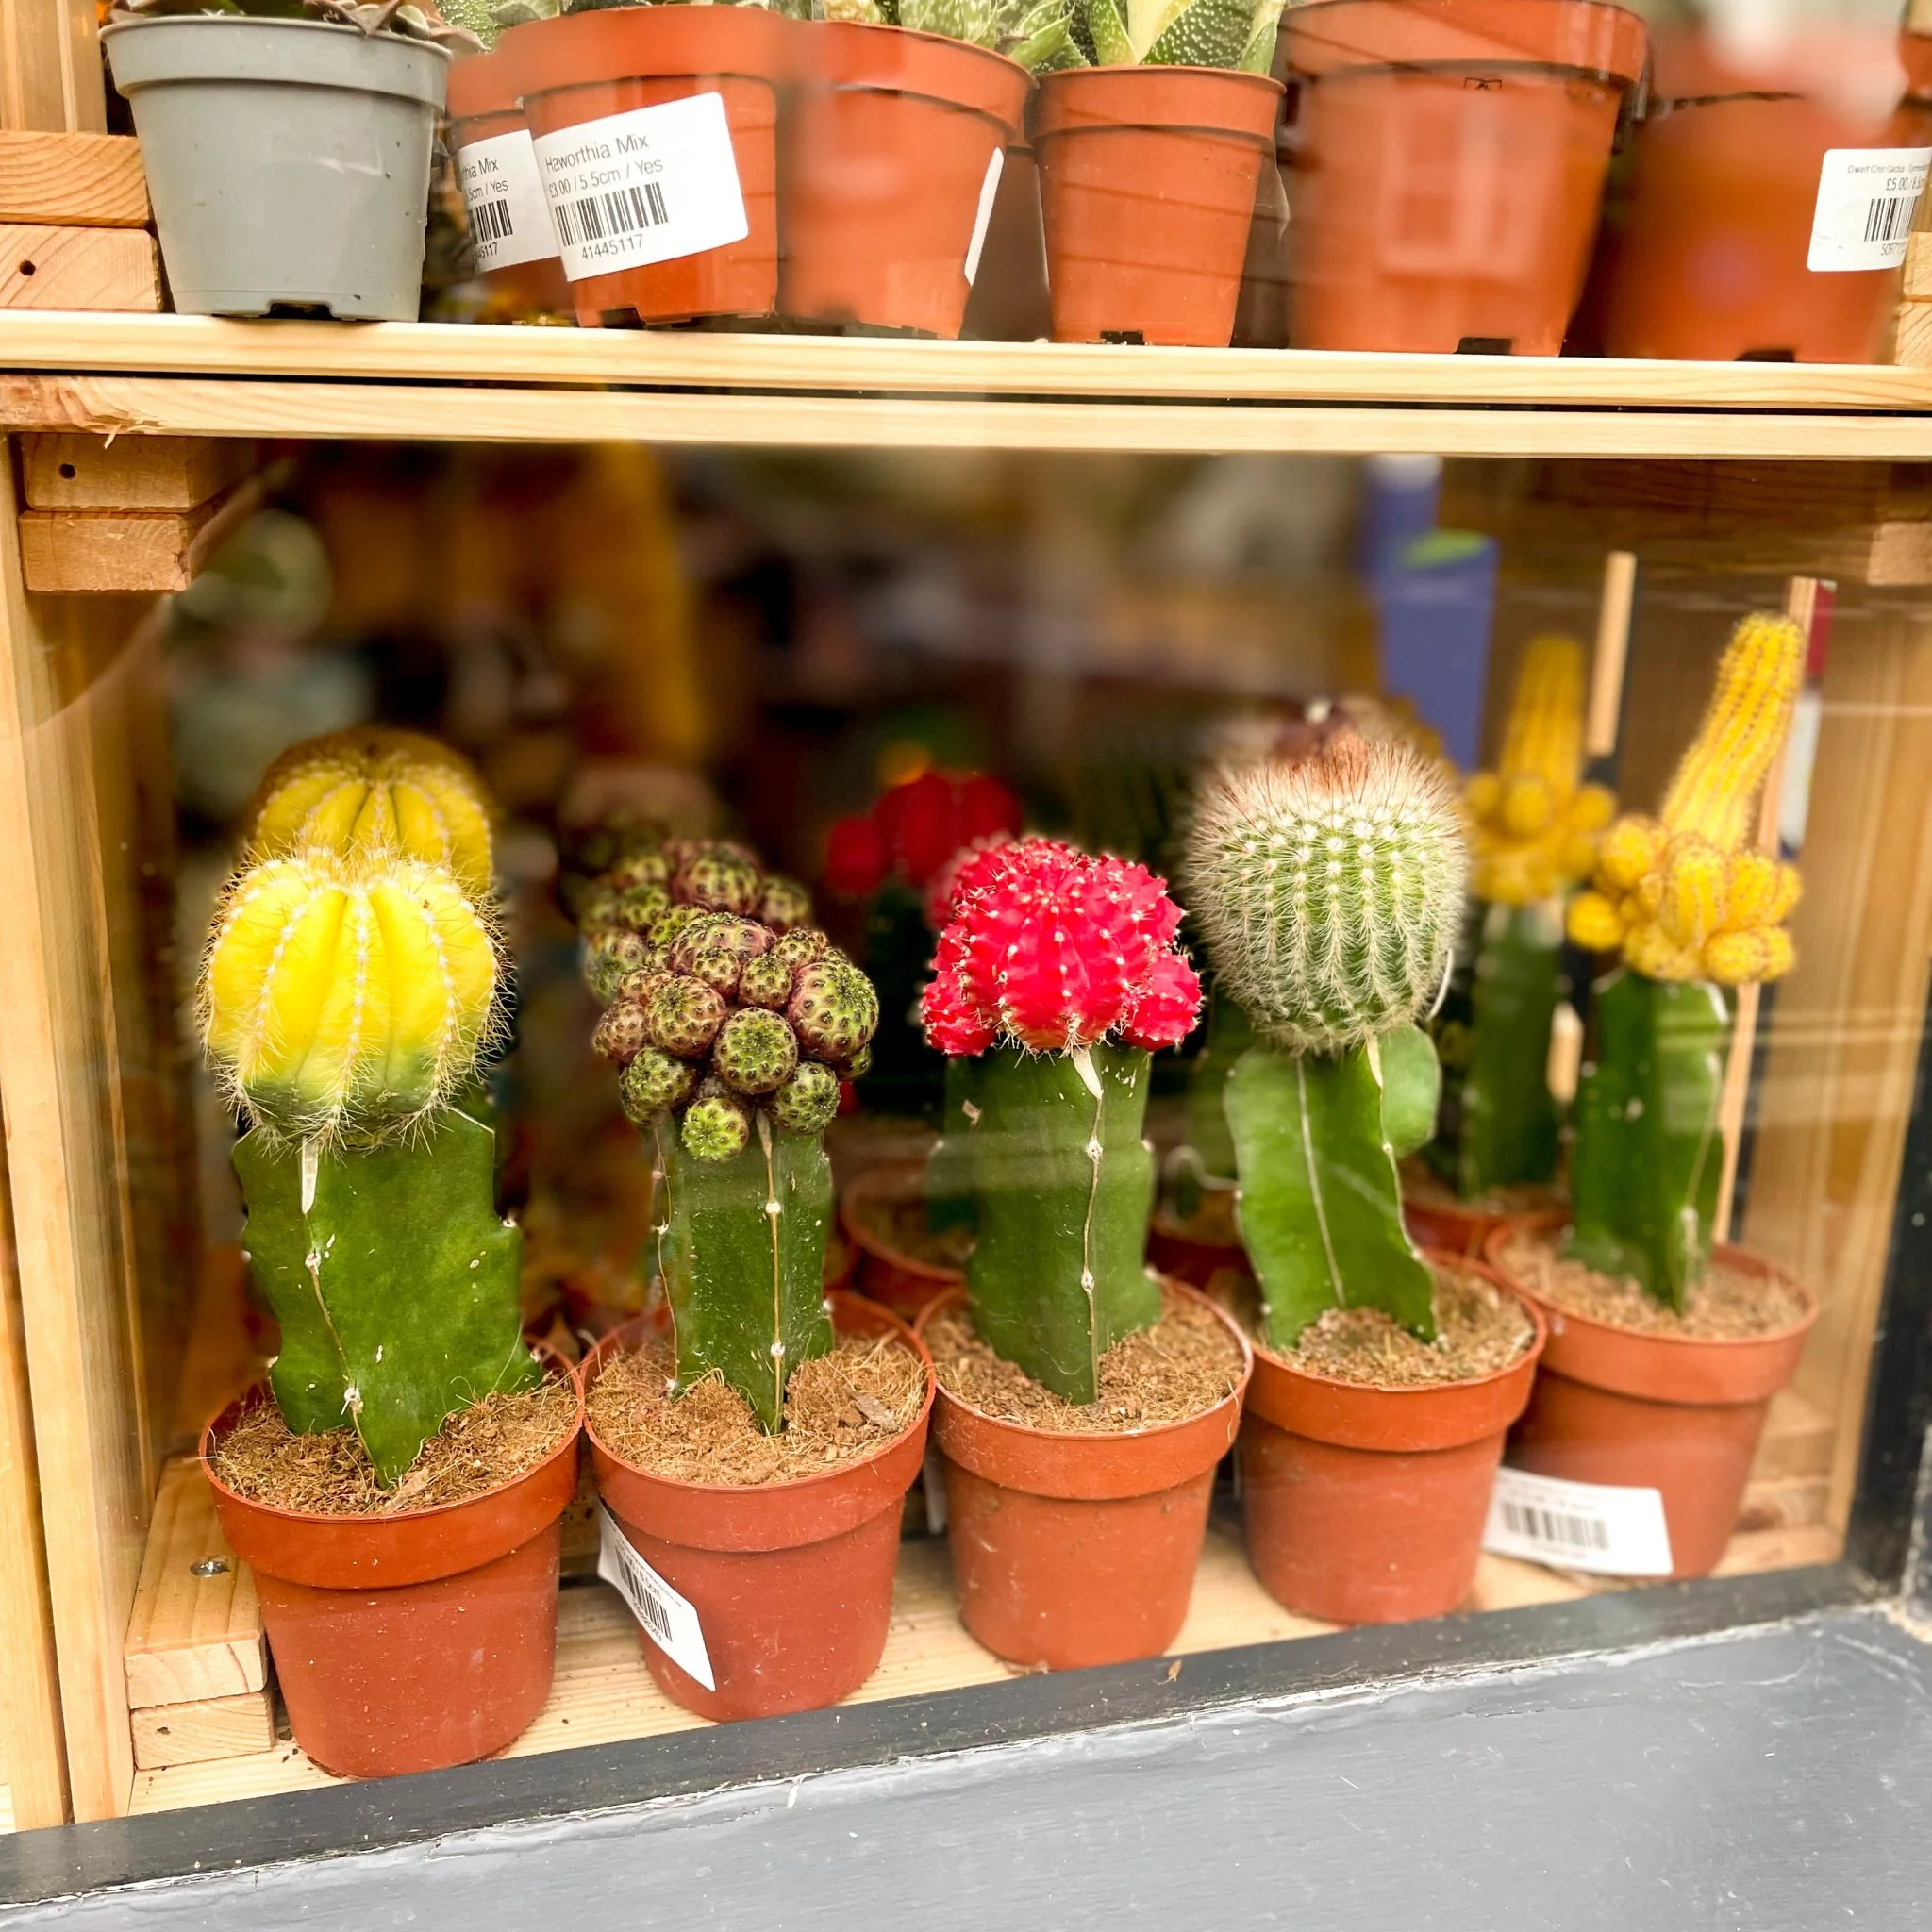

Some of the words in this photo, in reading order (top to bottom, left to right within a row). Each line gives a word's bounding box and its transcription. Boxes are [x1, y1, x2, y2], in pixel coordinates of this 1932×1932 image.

[544, 141, 611, 174] Haworthia
[615, 133, 650, 155] Mix
[490, 179, 509, 193] Yes
[579, 168, 622, 191] 5.5cm
[633, 158, 664, 175] Yes
[581, 233, 643, 260] 41445117
